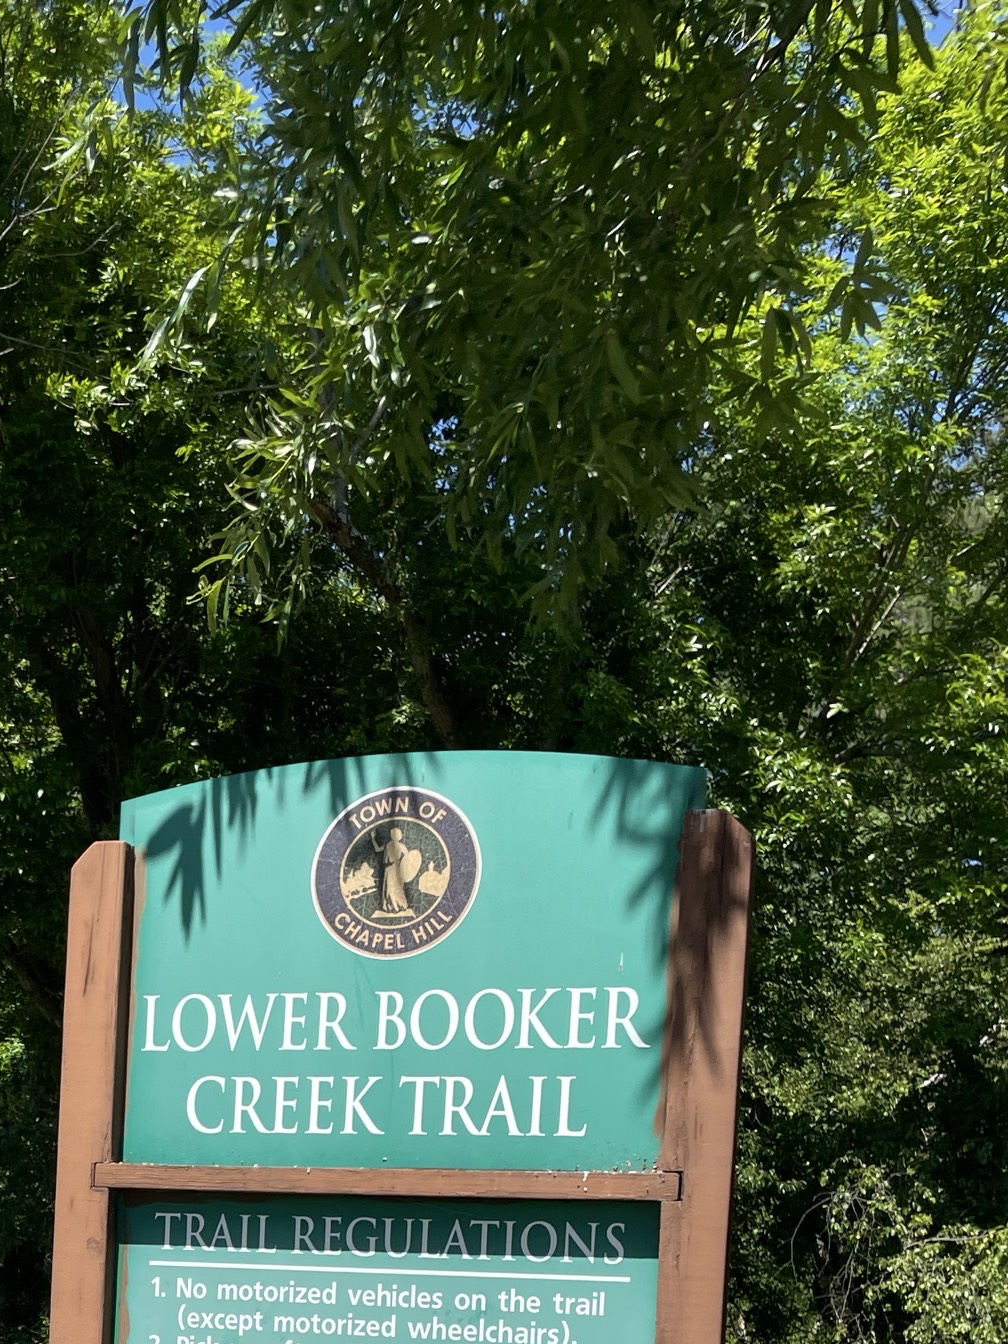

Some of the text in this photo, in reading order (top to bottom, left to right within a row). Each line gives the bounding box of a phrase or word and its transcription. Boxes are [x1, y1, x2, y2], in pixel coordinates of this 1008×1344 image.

[348, 796, 448, 830] TOWN OF
[334, 910, 454, 950] CHAPEL HILL
[141, 986, 651, 1052] LOWER BOOKER
[186, 1075, 587, 1137] CREEK TRAIL
[154, 1211, 626, 1265] TRAIL REGULATIONS
[151, 1276, 605, 1316] 1. No motorized vehicles on the trail
[178, 1304, 263, 1336] (except
[274, 1313, 396, 1337] motorized
